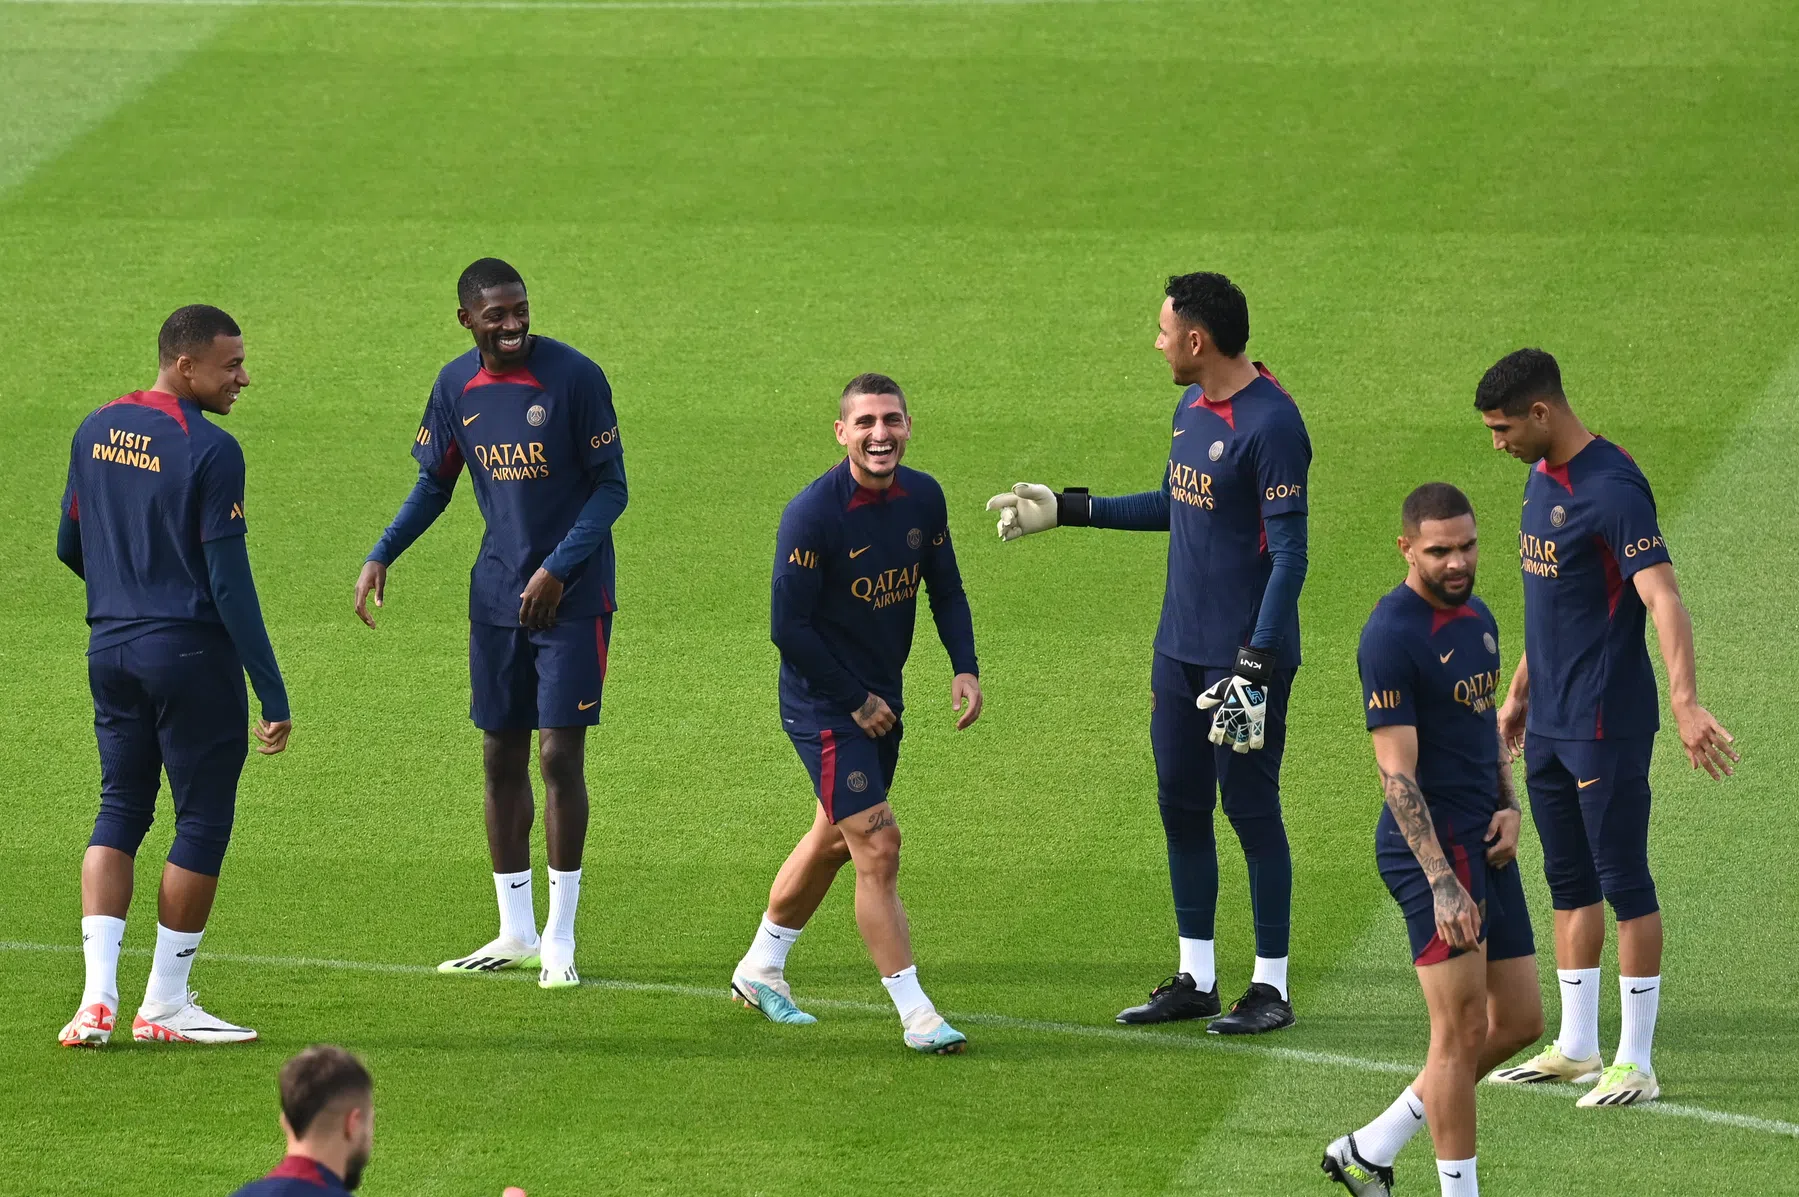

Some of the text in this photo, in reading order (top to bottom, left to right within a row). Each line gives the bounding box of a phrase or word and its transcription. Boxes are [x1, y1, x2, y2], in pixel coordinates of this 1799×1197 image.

[109, 428, 152, 452] VISIT
[92, 443, 161, 473] RWANDA
[474, 442, 548, 471] QATAR
[492, 464, 550, 481] AIRWAYS
[1171, 485, 1214, 511] AIRWAYS
[1265, 483, 1302, 501] GOAT
[1240, 658, 1262, 670] KN1
